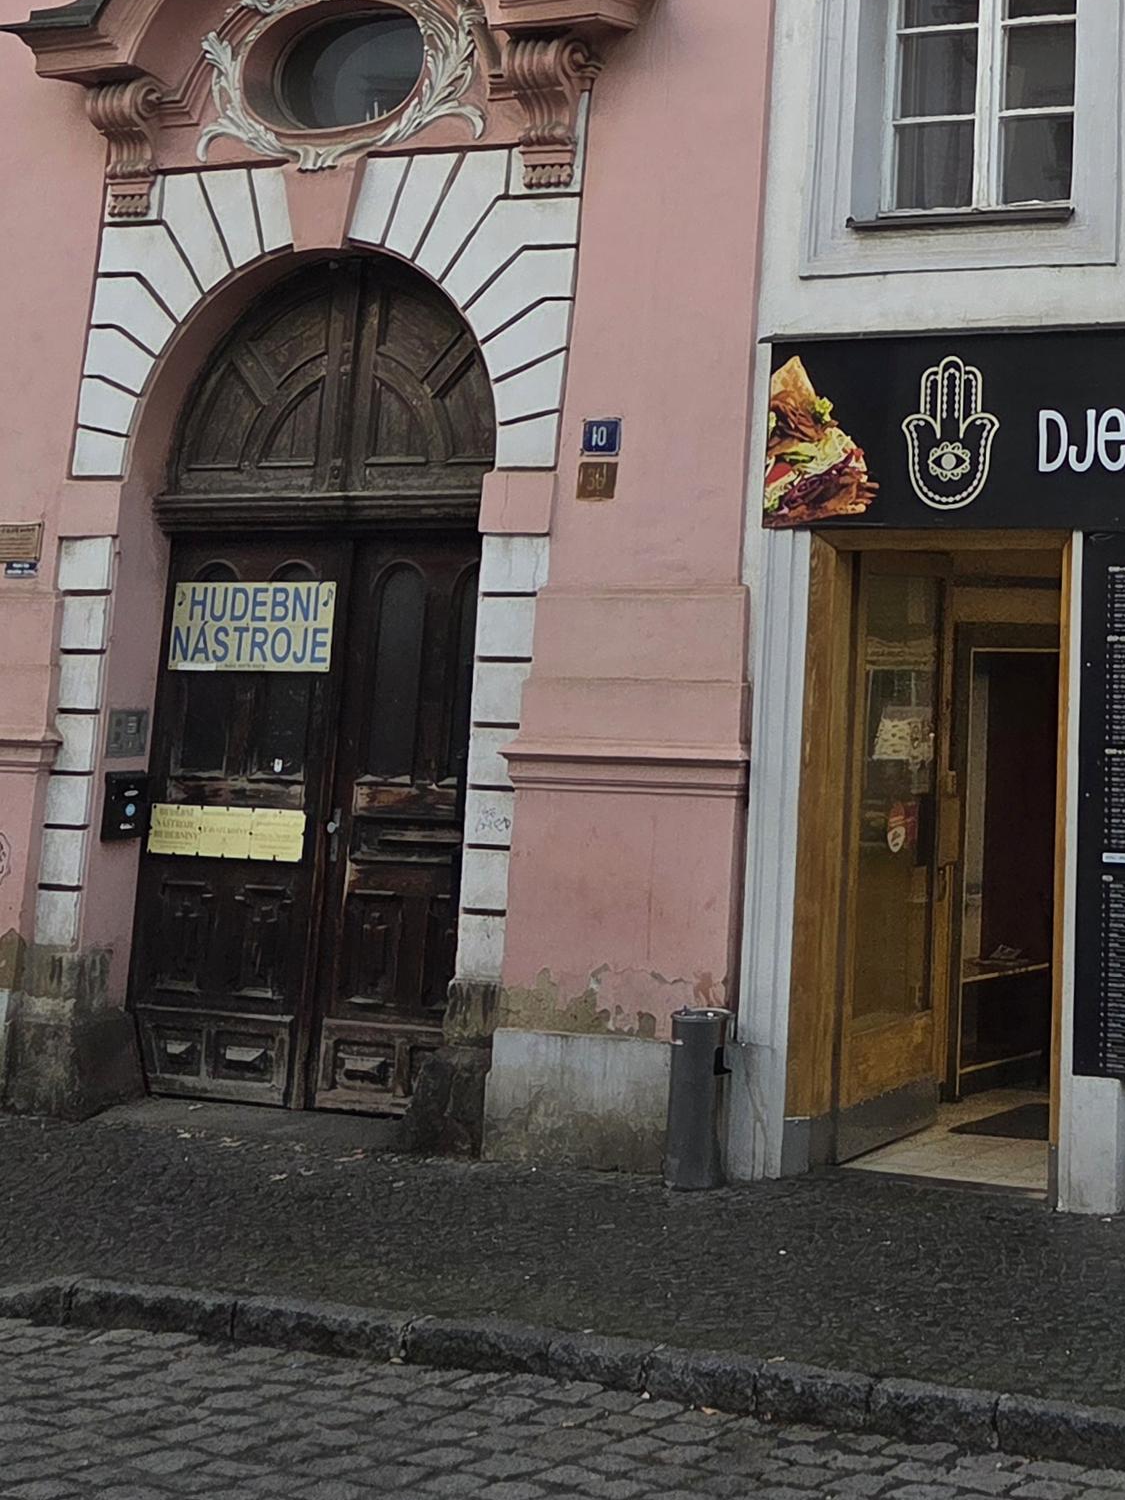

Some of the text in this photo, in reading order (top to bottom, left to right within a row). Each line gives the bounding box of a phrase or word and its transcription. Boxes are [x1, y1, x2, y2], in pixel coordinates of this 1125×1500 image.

[591, 425, 607, 447] 10
[188, 581, 324, 622] HUDEBNÍ
[171, 620, 330, 664] NÁSTROJE
